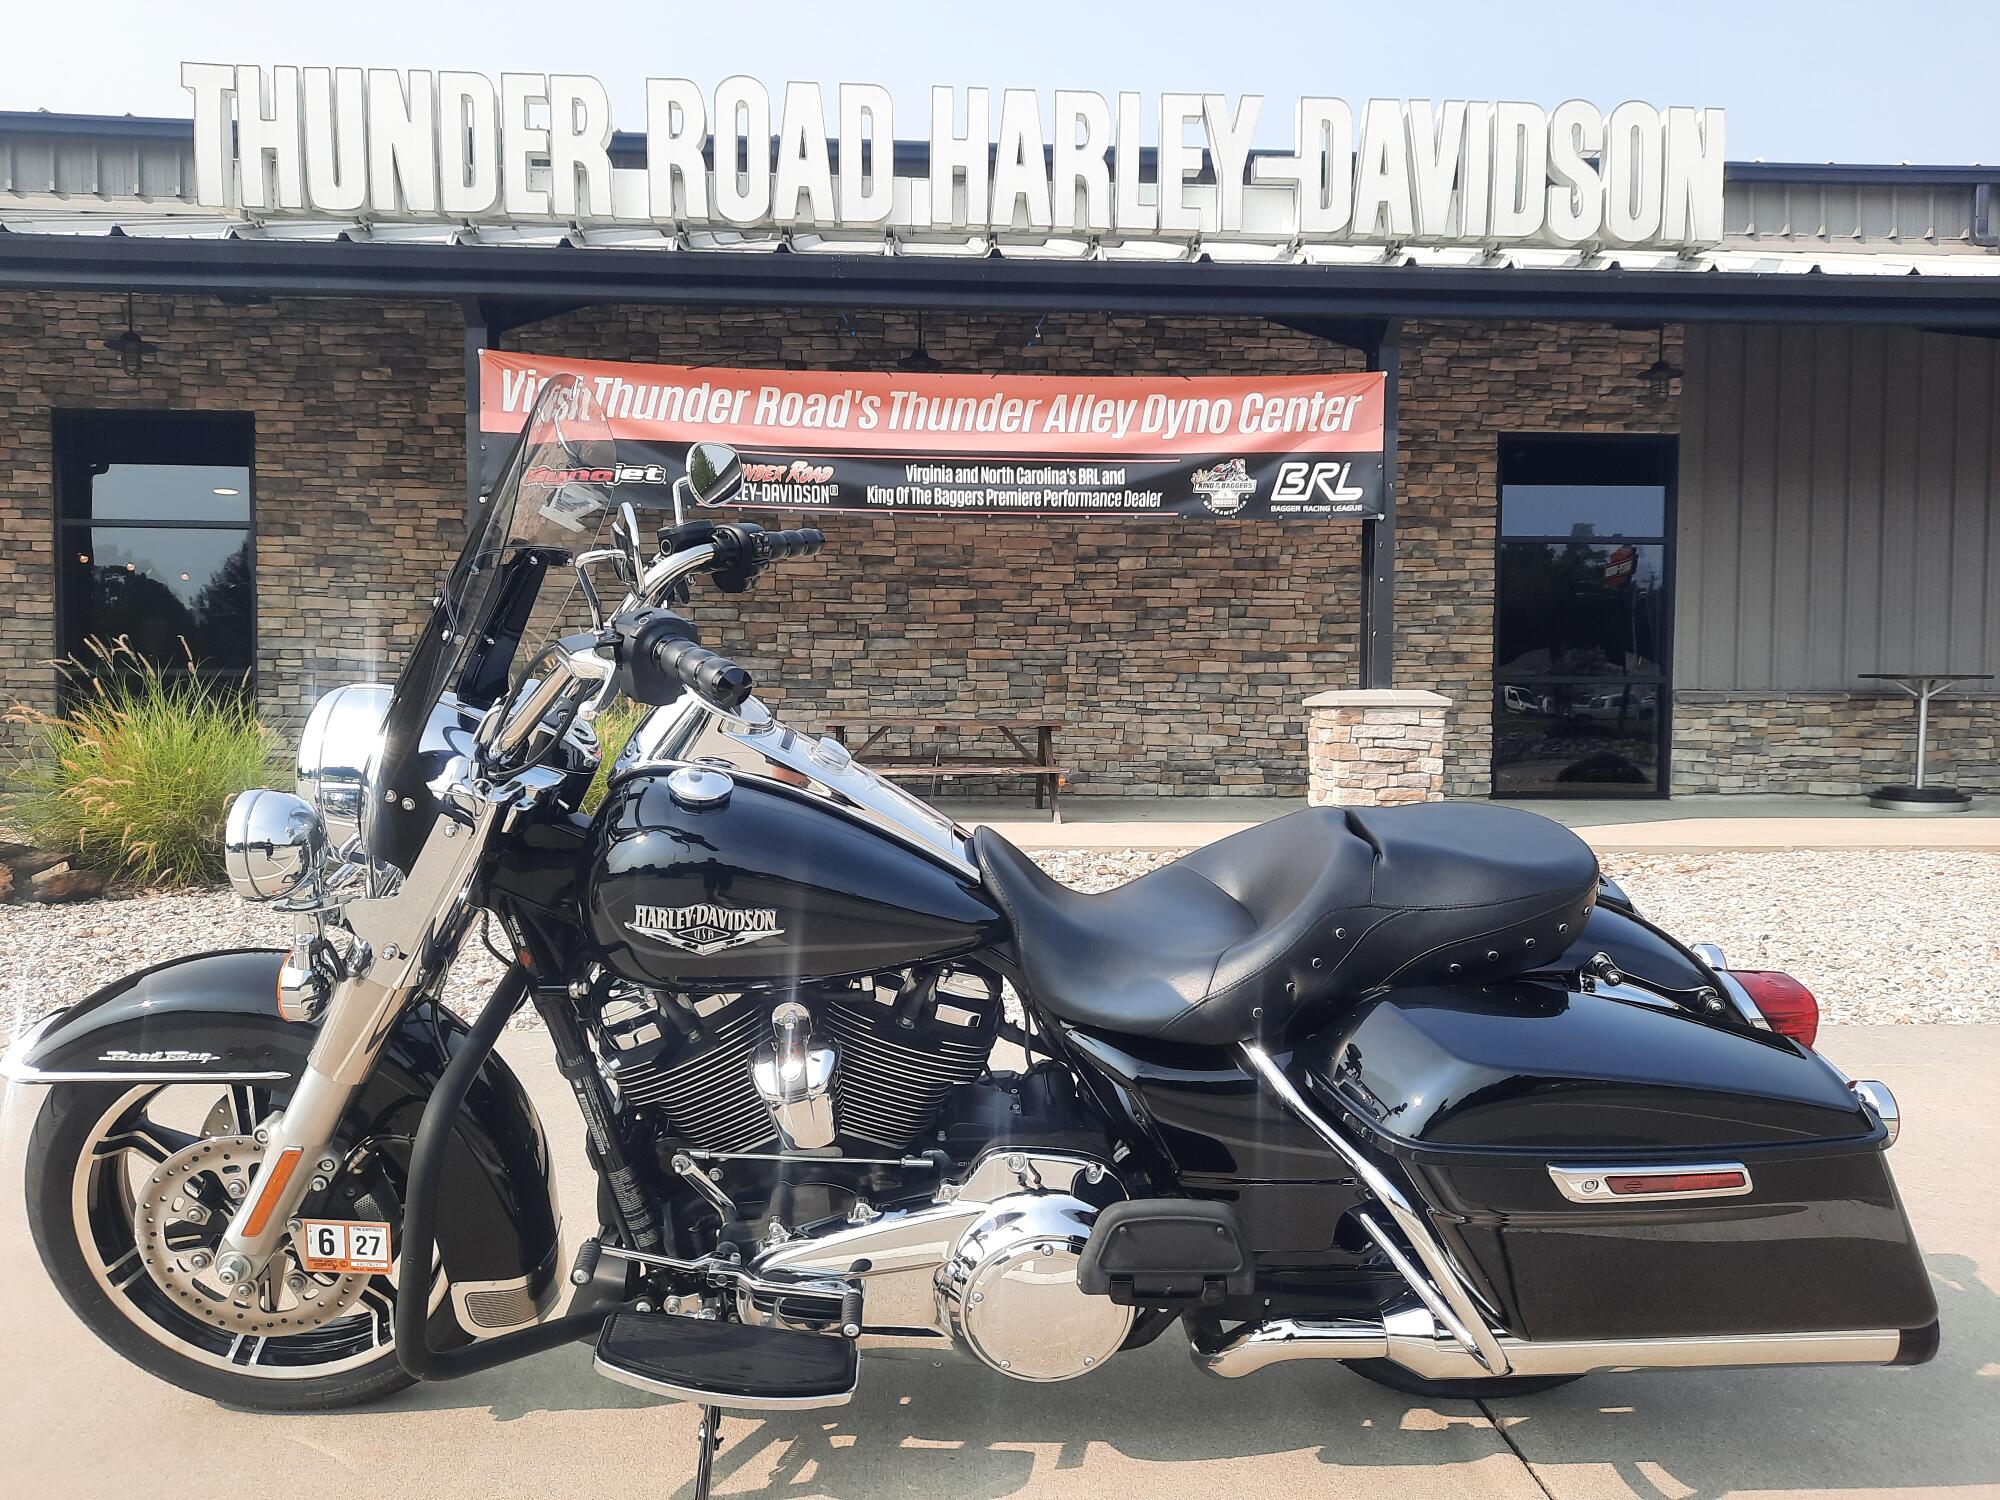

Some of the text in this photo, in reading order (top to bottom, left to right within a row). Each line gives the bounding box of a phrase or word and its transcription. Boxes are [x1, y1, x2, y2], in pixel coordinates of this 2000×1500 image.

[181, 62, 1726, 246] THUNDER ROAD HARLEY-DAVIDSON
[594, 377, 751, 425] Thunder
[753, 386, 880, 430] Road's
[888, 390, 1042, 433] Thunder
[1042, 394, 1139, 439] Alley
[1140, 393, 1232, 440] Dyno
[1238, 391, 1364, 434] Center
[742, 463, 788, 482] NDER
[905, 464, 1126, 485] Virginia and North Carolina's BRL and
[1270, 462, 1364, 501] BRL
[866, 485, 1163, 508] King Of The Baggers Premiere Performance Dealer
[1332, 504, 1363, 512] LEAGUE
[694, 928, 714, 940] USA
[318, 1228, 335, 1256] 6
[355, 1235, 381, 1256] 27
